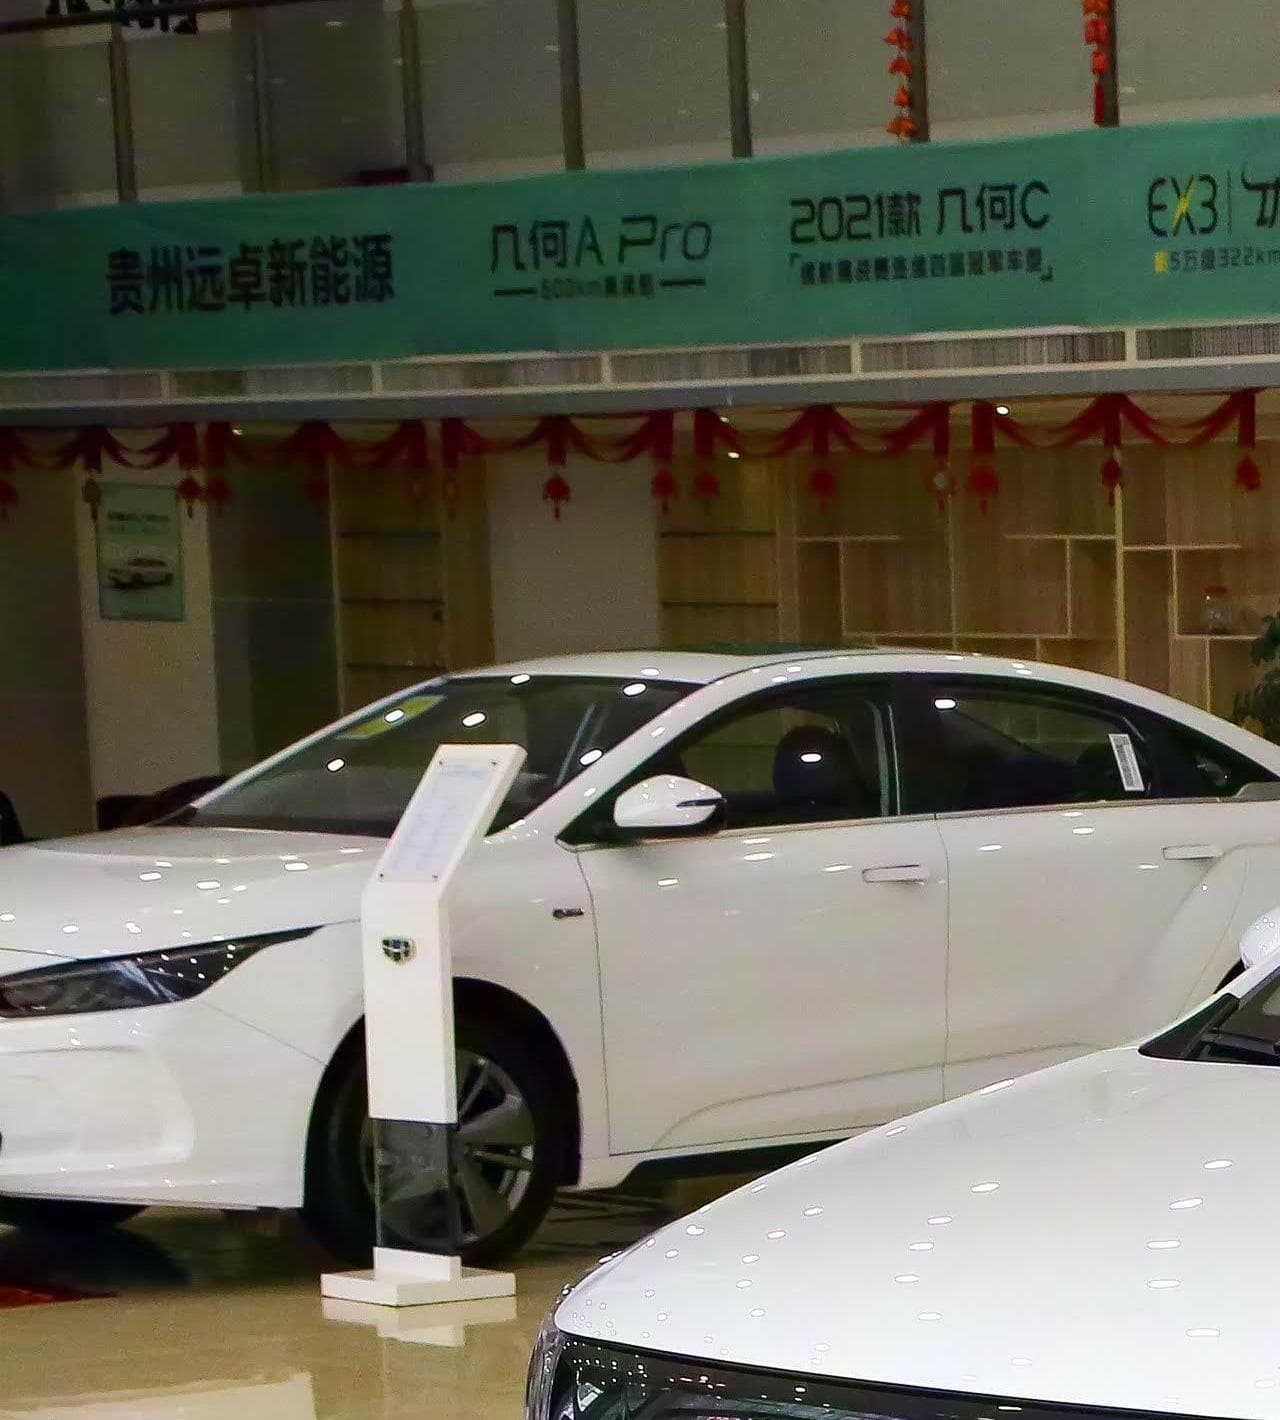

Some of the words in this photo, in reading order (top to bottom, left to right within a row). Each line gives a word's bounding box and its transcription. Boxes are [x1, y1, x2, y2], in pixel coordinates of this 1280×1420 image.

[490, 215, 604, 274] 几何A
[617, 213, 712, 265] Pro
[790, 190, 922, 245] 2021款
[105, 233, 395, 317] 贵州远卓新能源
